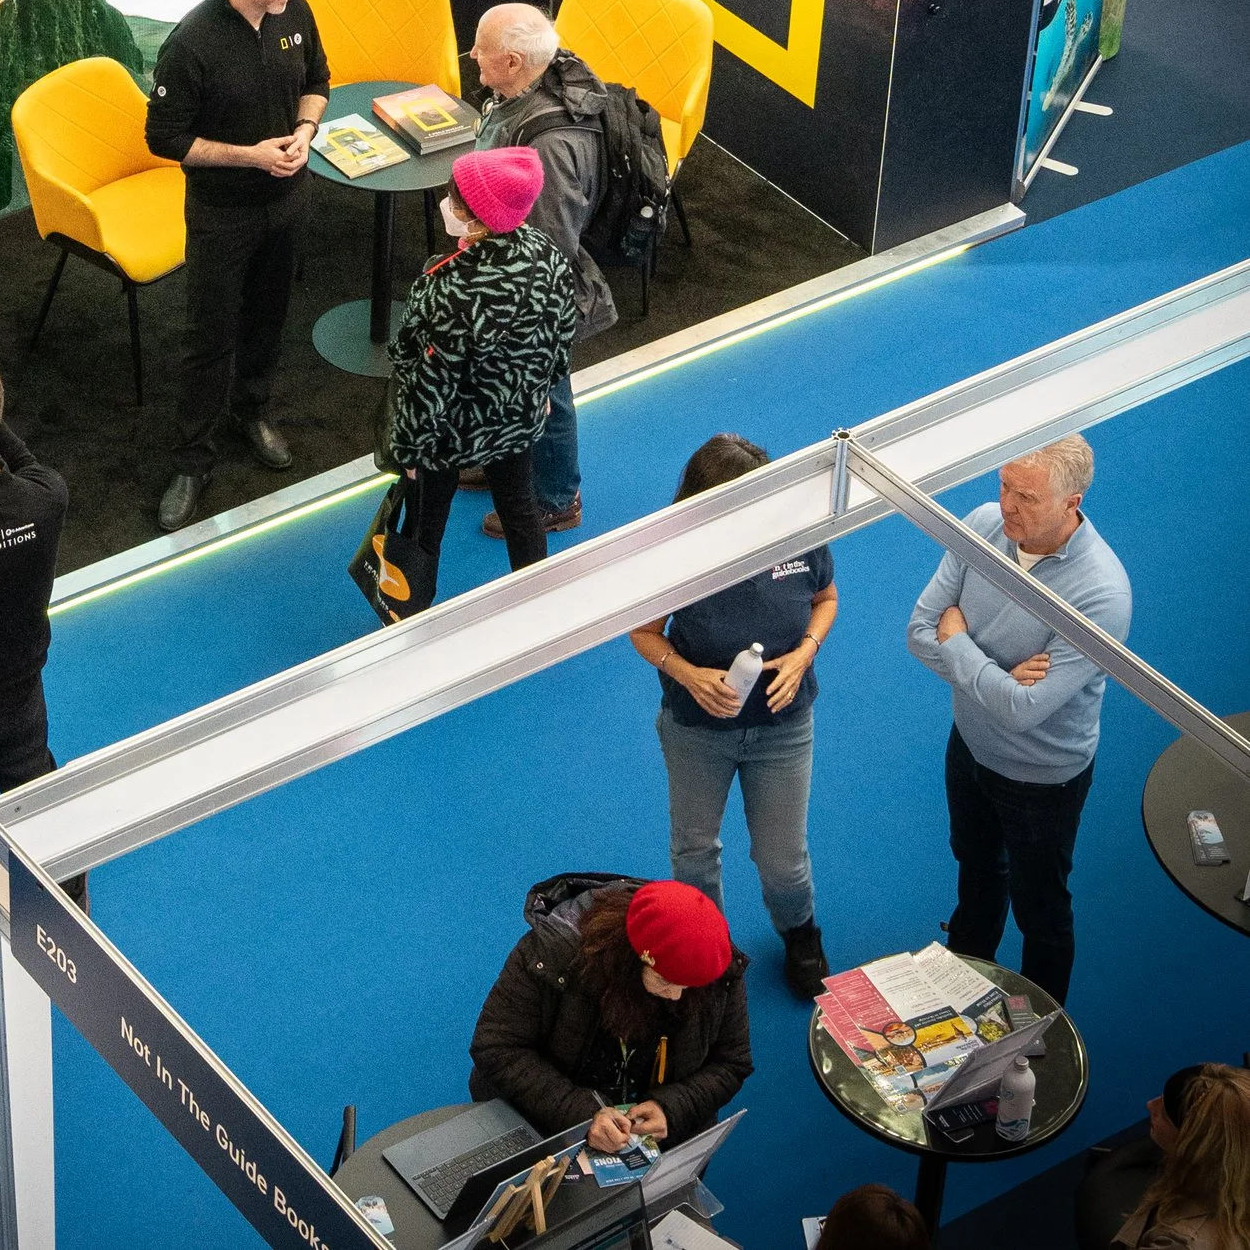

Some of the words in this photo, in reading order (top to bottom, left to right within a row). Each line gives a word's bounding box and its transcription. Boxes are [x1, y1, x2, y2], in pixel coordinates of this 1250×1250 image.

[37, 924, 77, 984] E203
[121, 1016, 151, 1067] Not
[156, 1055, 172, 1090] In
[178, 1078, 210, 1132] The
[216, 1124, 268, 1195] Guide
